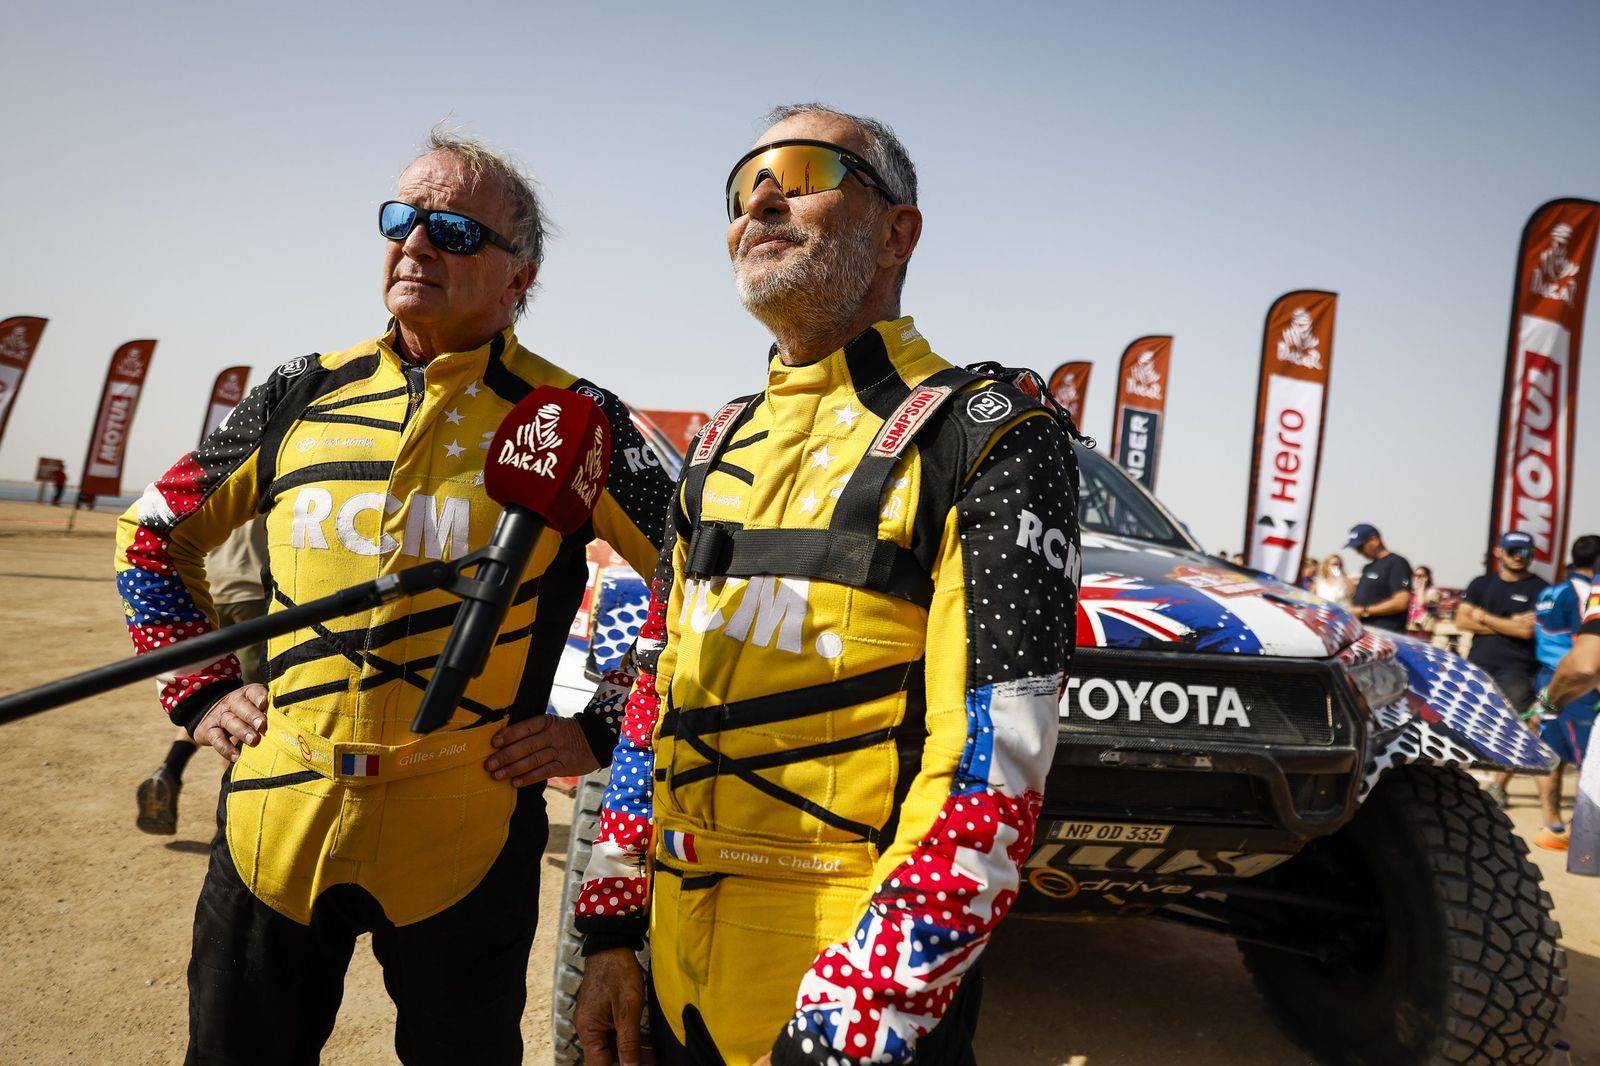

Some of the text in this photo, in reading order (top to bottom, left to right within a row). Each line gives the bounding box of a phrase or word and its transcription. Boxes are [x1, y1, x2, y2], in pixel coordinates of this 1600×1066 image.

[100, 399, 129, 462] MOTUL
[699, 408, 736, 457] SIMPSON
[882, 393, 935, 450] SIMPSON
[497, 439, 558, 479] DAKAR
[1270, 408, 1305, 503] Hero
[1516, 366, 1554, 555] MOTUL
[570, 465, 597, 509] DAKAR
[291, 487, 471, 560] RCM
[1058, 677, 1251, 728] TOYOTA
[399, 742, 468, 767] Gilles Pillot
[1066, 823, 1094, 838] NP
[1126, 826, 1166, 841] 335
[719, 847, 842, 873] Ronan Chabot
